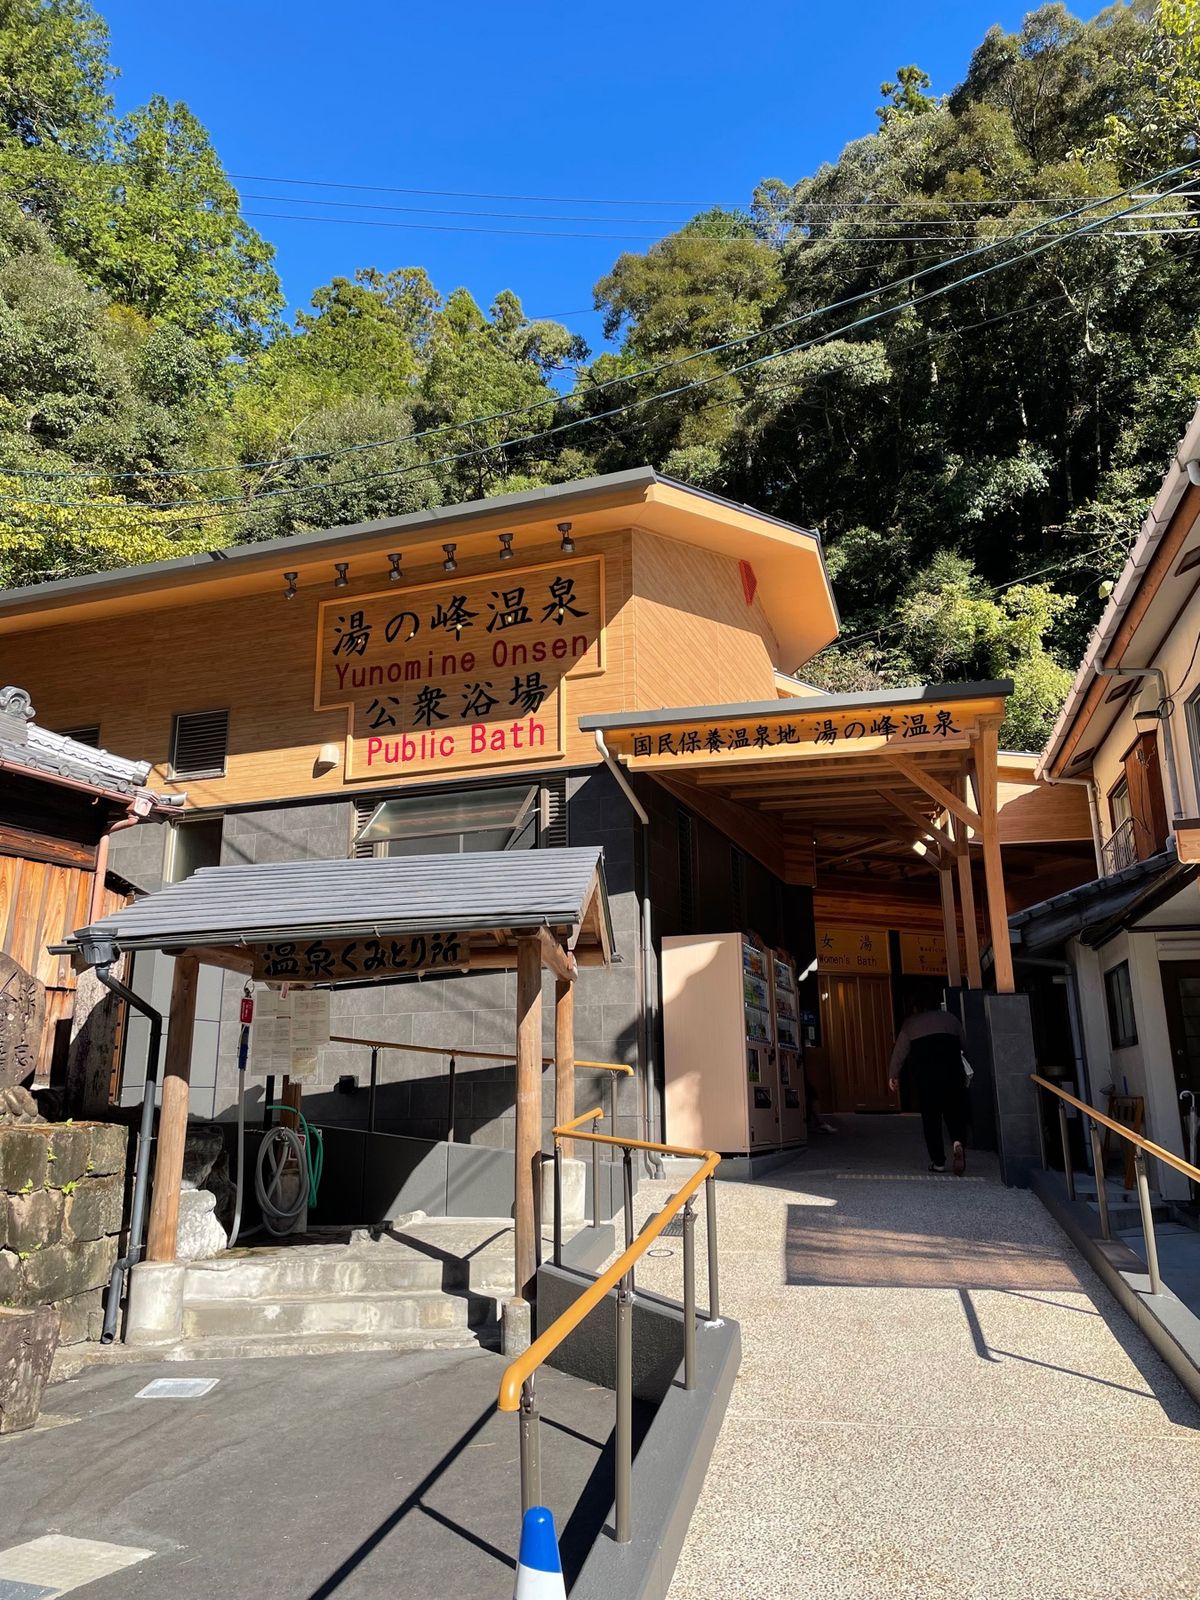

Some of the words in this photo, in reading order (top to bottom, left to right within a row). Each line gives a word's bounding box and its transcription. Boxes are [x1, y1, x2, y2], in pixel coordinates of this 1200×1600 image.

[332, 576, 589, 656] 湯の峰温泉
[335, 650, 476, 689] Yunomine
[492, 634, 588, 667] Onsen
[366, 672, 548, 730] 公衆浴場
[367, 731, 455, 766] Public
[470, 717, 545, 753] Bath
[634, 724, 800, 758] 国民保養温泉地
[814, 710, 962, 746] 湯の峰温泉
[264, 932, 461, 977] 温泉くみとり所
[819, 954, 850, 966] Women's
[857, 955, 877, 967] Bath
